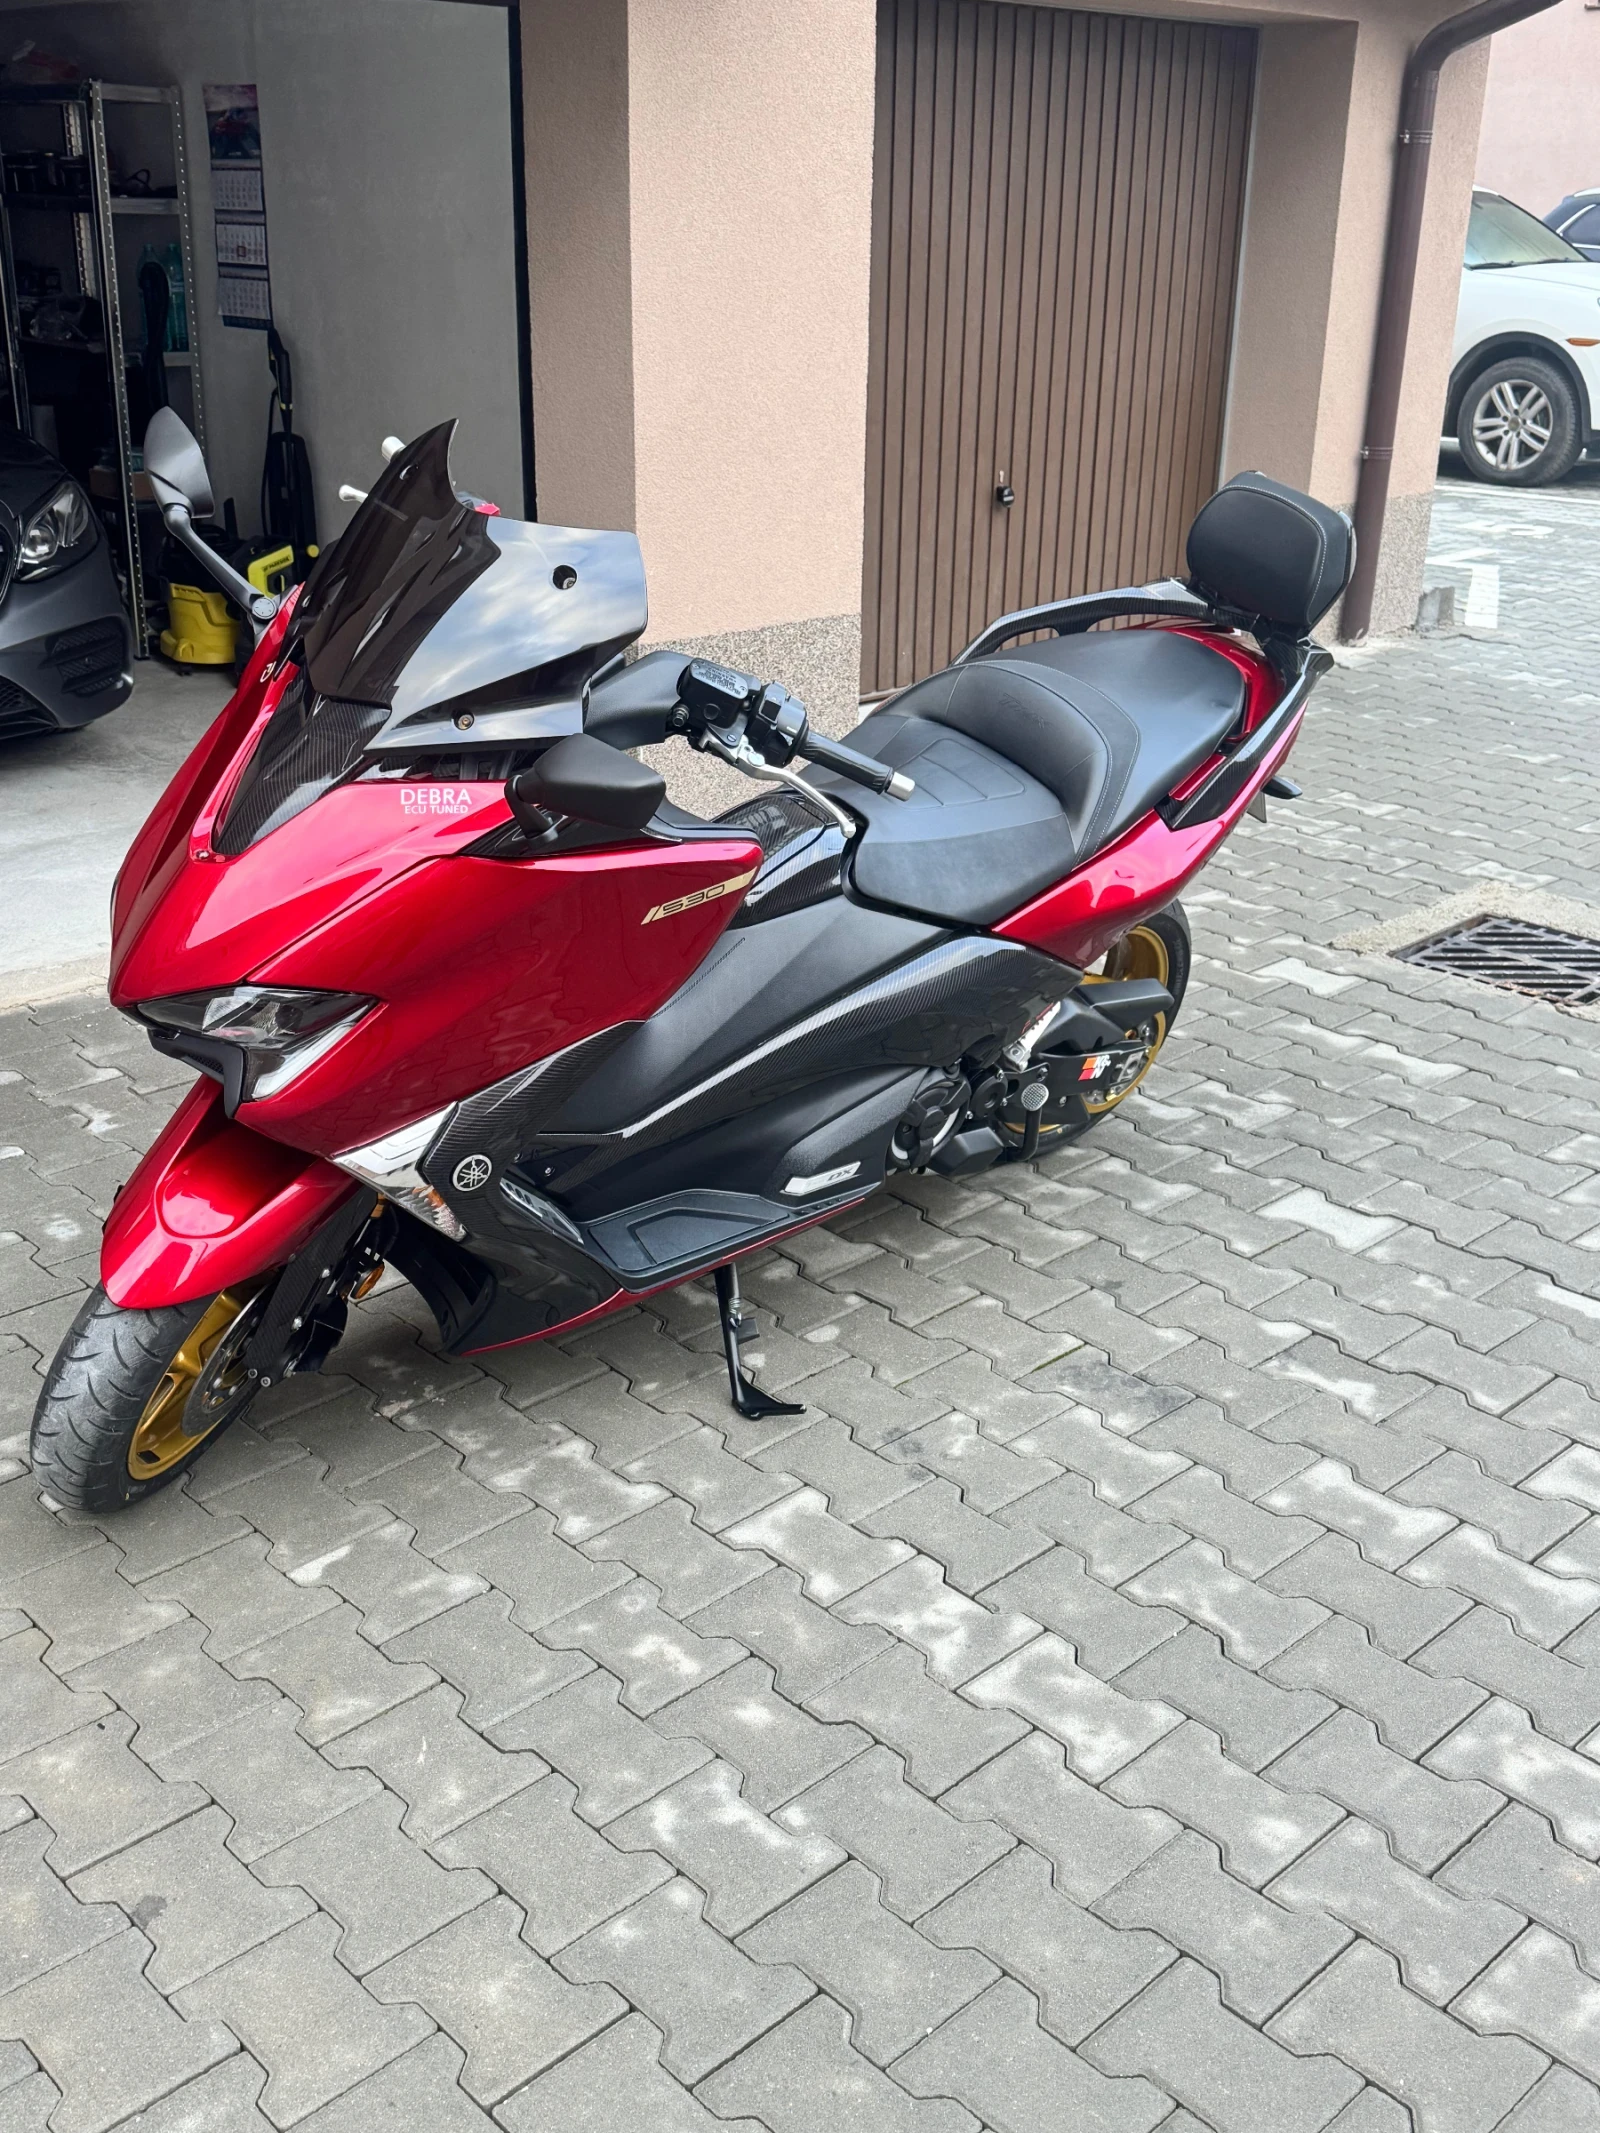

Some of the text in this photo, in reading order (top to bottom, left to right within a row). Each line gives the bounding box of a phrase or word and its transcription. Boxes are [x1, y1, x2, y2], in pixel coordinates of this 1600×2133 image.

[400, 788, 472, 805] DEBRA
[404, 804, 469, 814] ECU TUNED
[662, 883, 725, 916] 530
